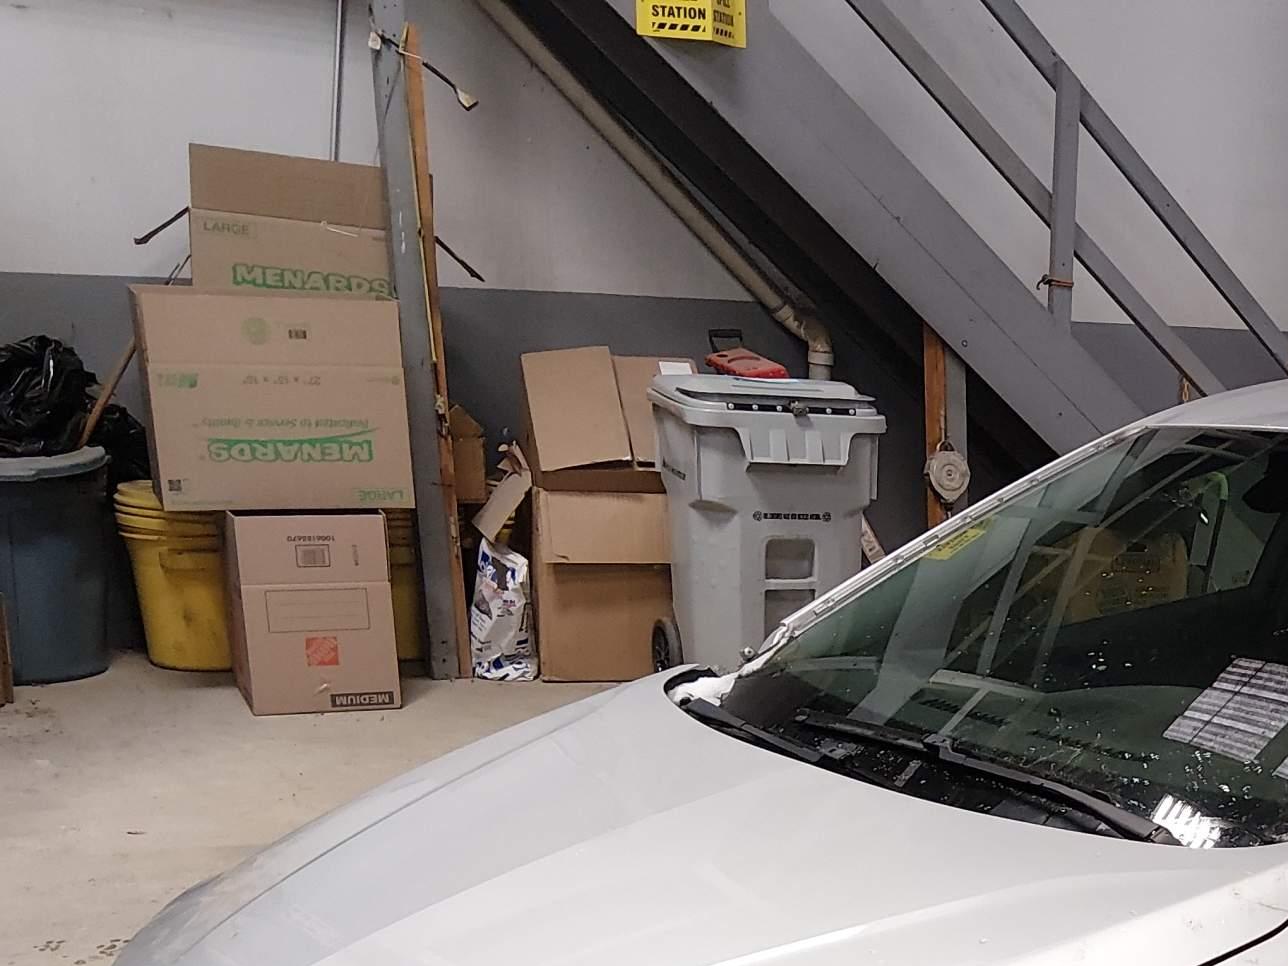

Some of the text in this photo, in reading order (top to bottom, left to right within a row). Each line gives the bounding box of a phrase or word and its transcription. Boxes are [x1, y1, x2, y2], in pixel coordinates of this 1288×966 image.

[652, 4, 706, 20] STATION
[713, 10, 734, 26] STATION
[203, 220, 249, 235] LARGE
[232, 264, 390, 297] MENARDS
[257, 418, 298, 429] Service
[208, 439, 374, 463] MENARDS
[358, 489, 404, 501] LARGE
[335, 693, 390, 706] MEDIUM
